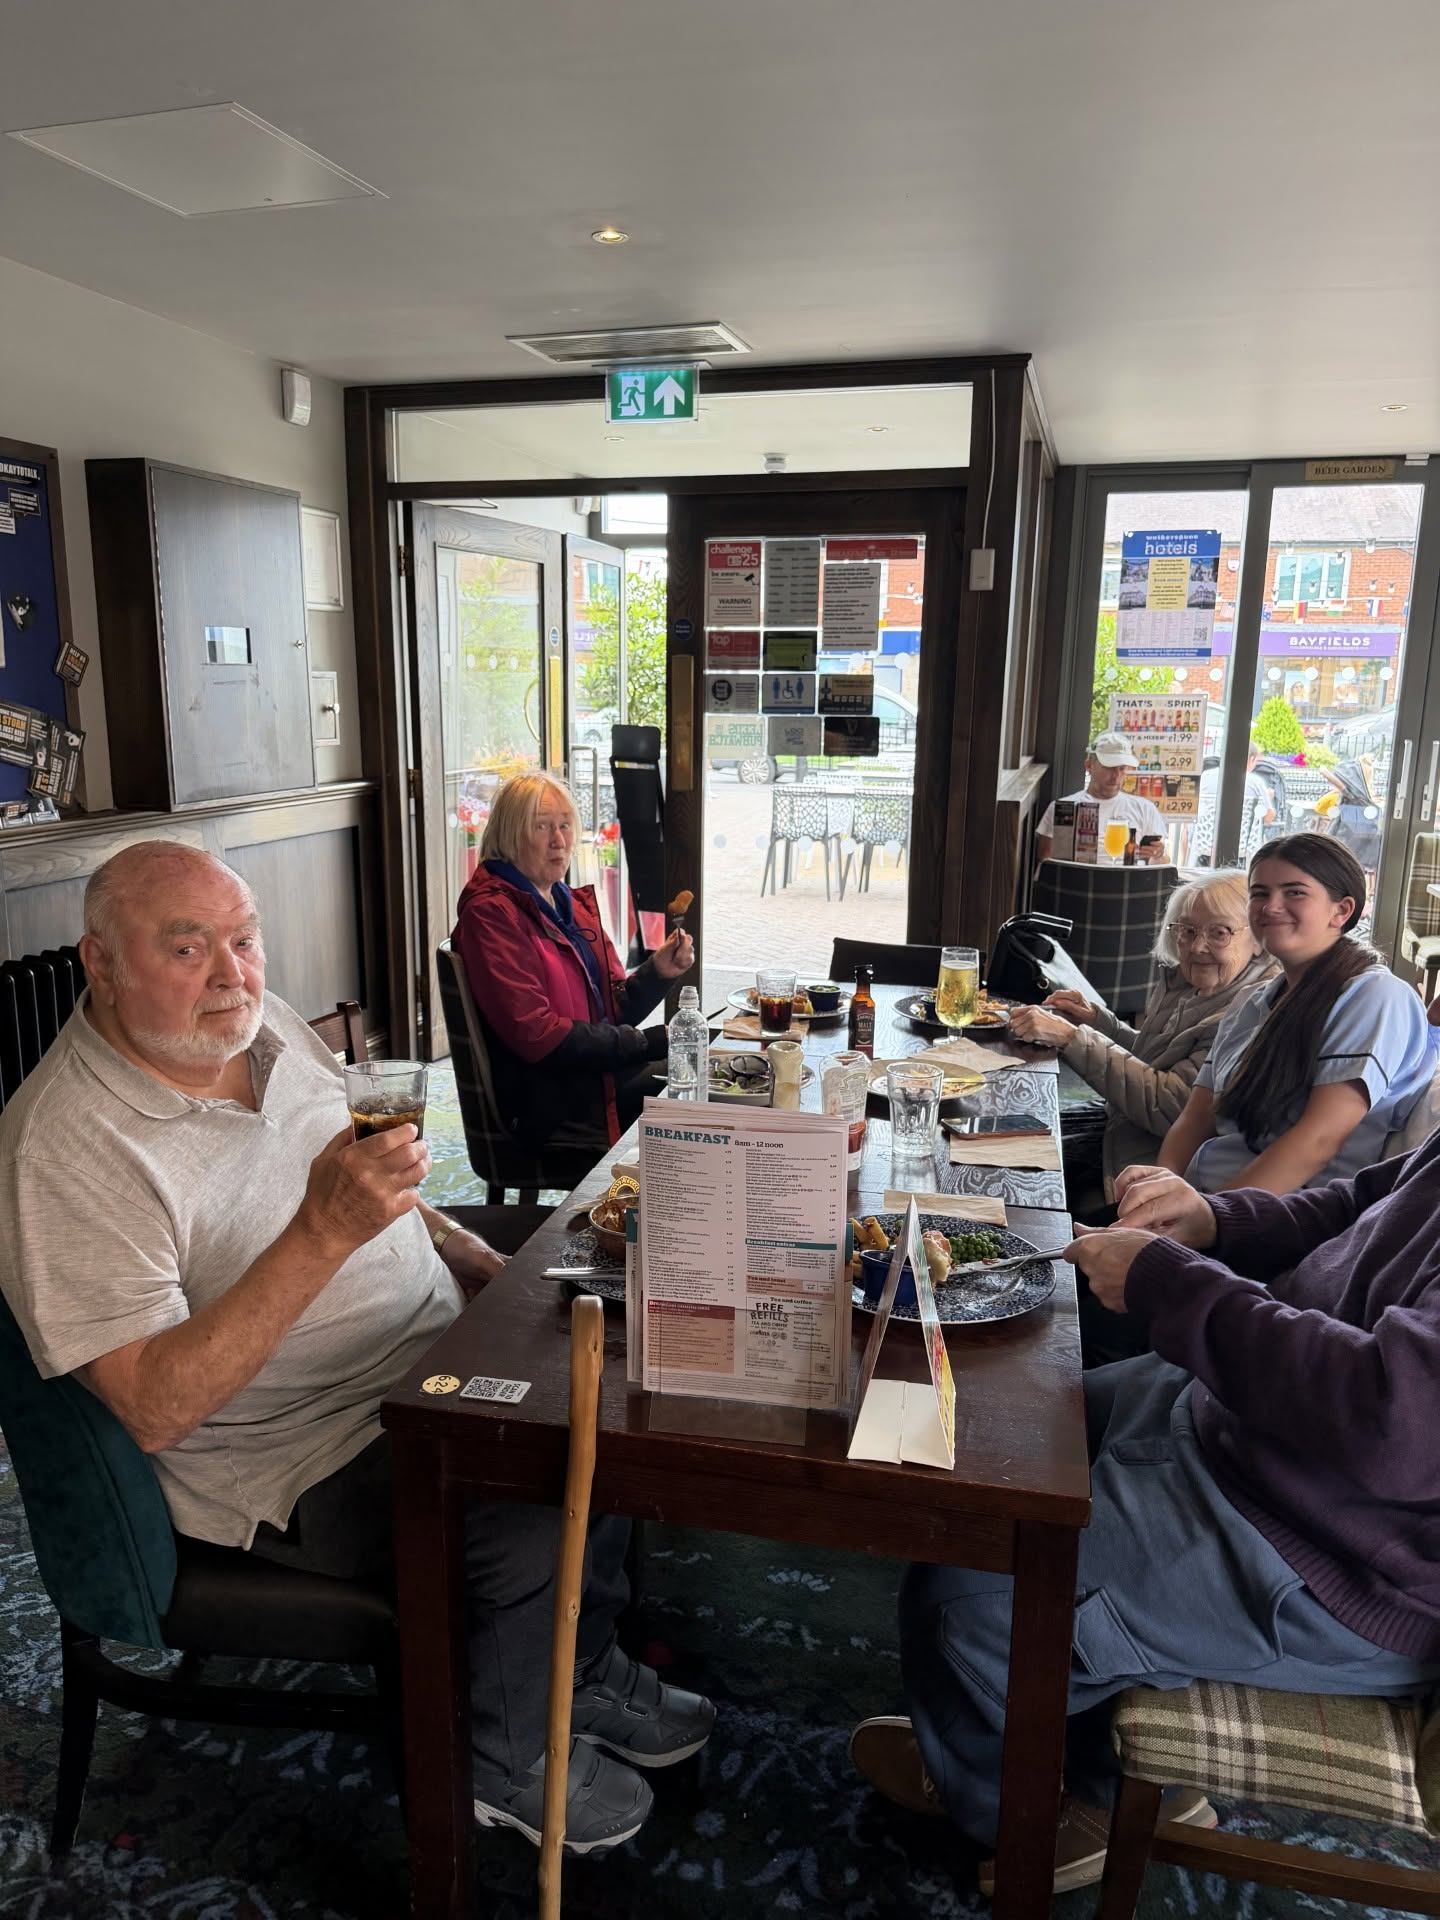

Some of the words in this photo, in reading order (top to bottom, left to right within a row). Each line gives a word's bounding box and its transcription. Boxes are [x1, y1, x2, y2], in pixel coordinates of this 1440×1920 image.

[1342, 466, 1386, 474] GARDEN
[711, 544, 752, 556] challenge
[1145, 541, 1198, 555] hotels
[742, 553, 758, 566] 25
[1290, 636, 1370, 646] BAYFIELDS
[1116, 700, 1152, 708] THAT'S
[1168, 700, 1202, 708] SPIRIT
[2, 716, 26, 730] STORM
[1168, 734, 1192, 742] £1.99
[1166, 758, 1192, 766] £2.99
[1166, 802, 1192, 811] £2.99
[644, 1126, 731, 1145] BREAKFAST
[756, 1302, 784, 1312] FREE
[750, 1312, 790, 1322] REFILLS
[432, 1376, 451, 1394] 624
